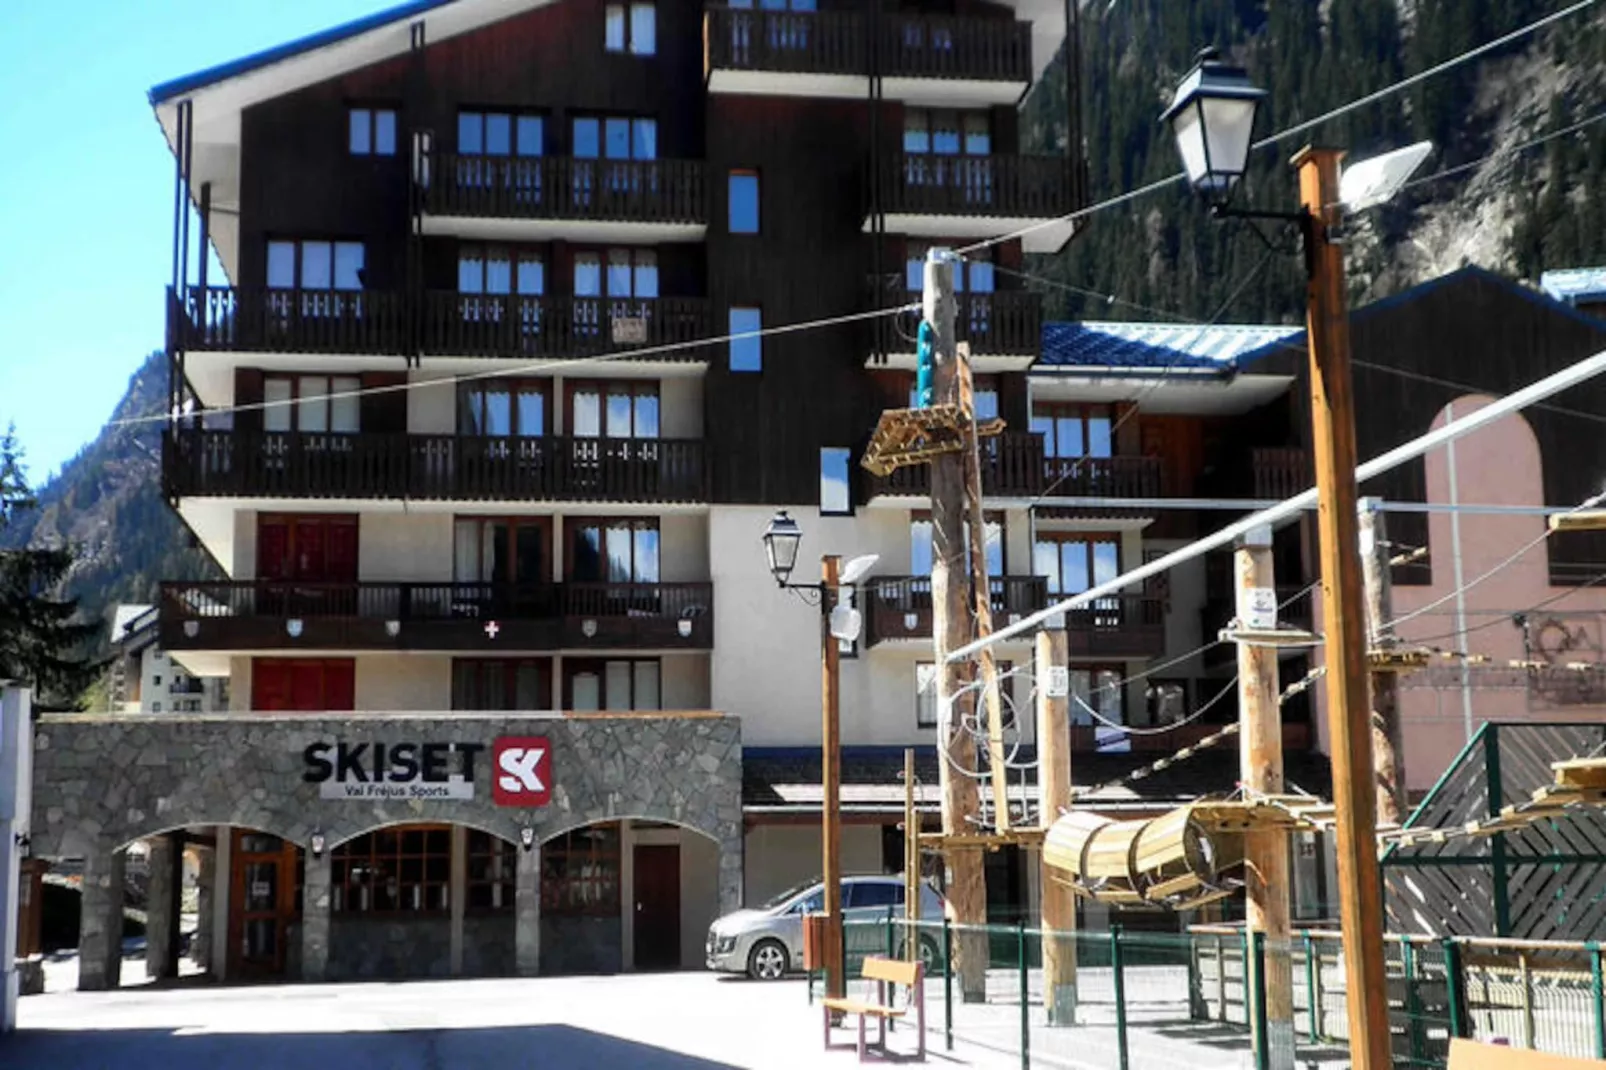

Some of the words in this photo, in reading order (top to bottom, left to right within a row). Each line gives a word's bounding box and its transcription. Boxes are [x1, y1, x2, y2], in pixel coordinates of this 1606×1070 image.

[302, 742, 484, 783] SKISET
[498, 748, 546, 792] SK
[344, 784, 364, 796] Val
[367, 783, 406, 800] Fréjus
[409, 784, 450, 799] Sports
